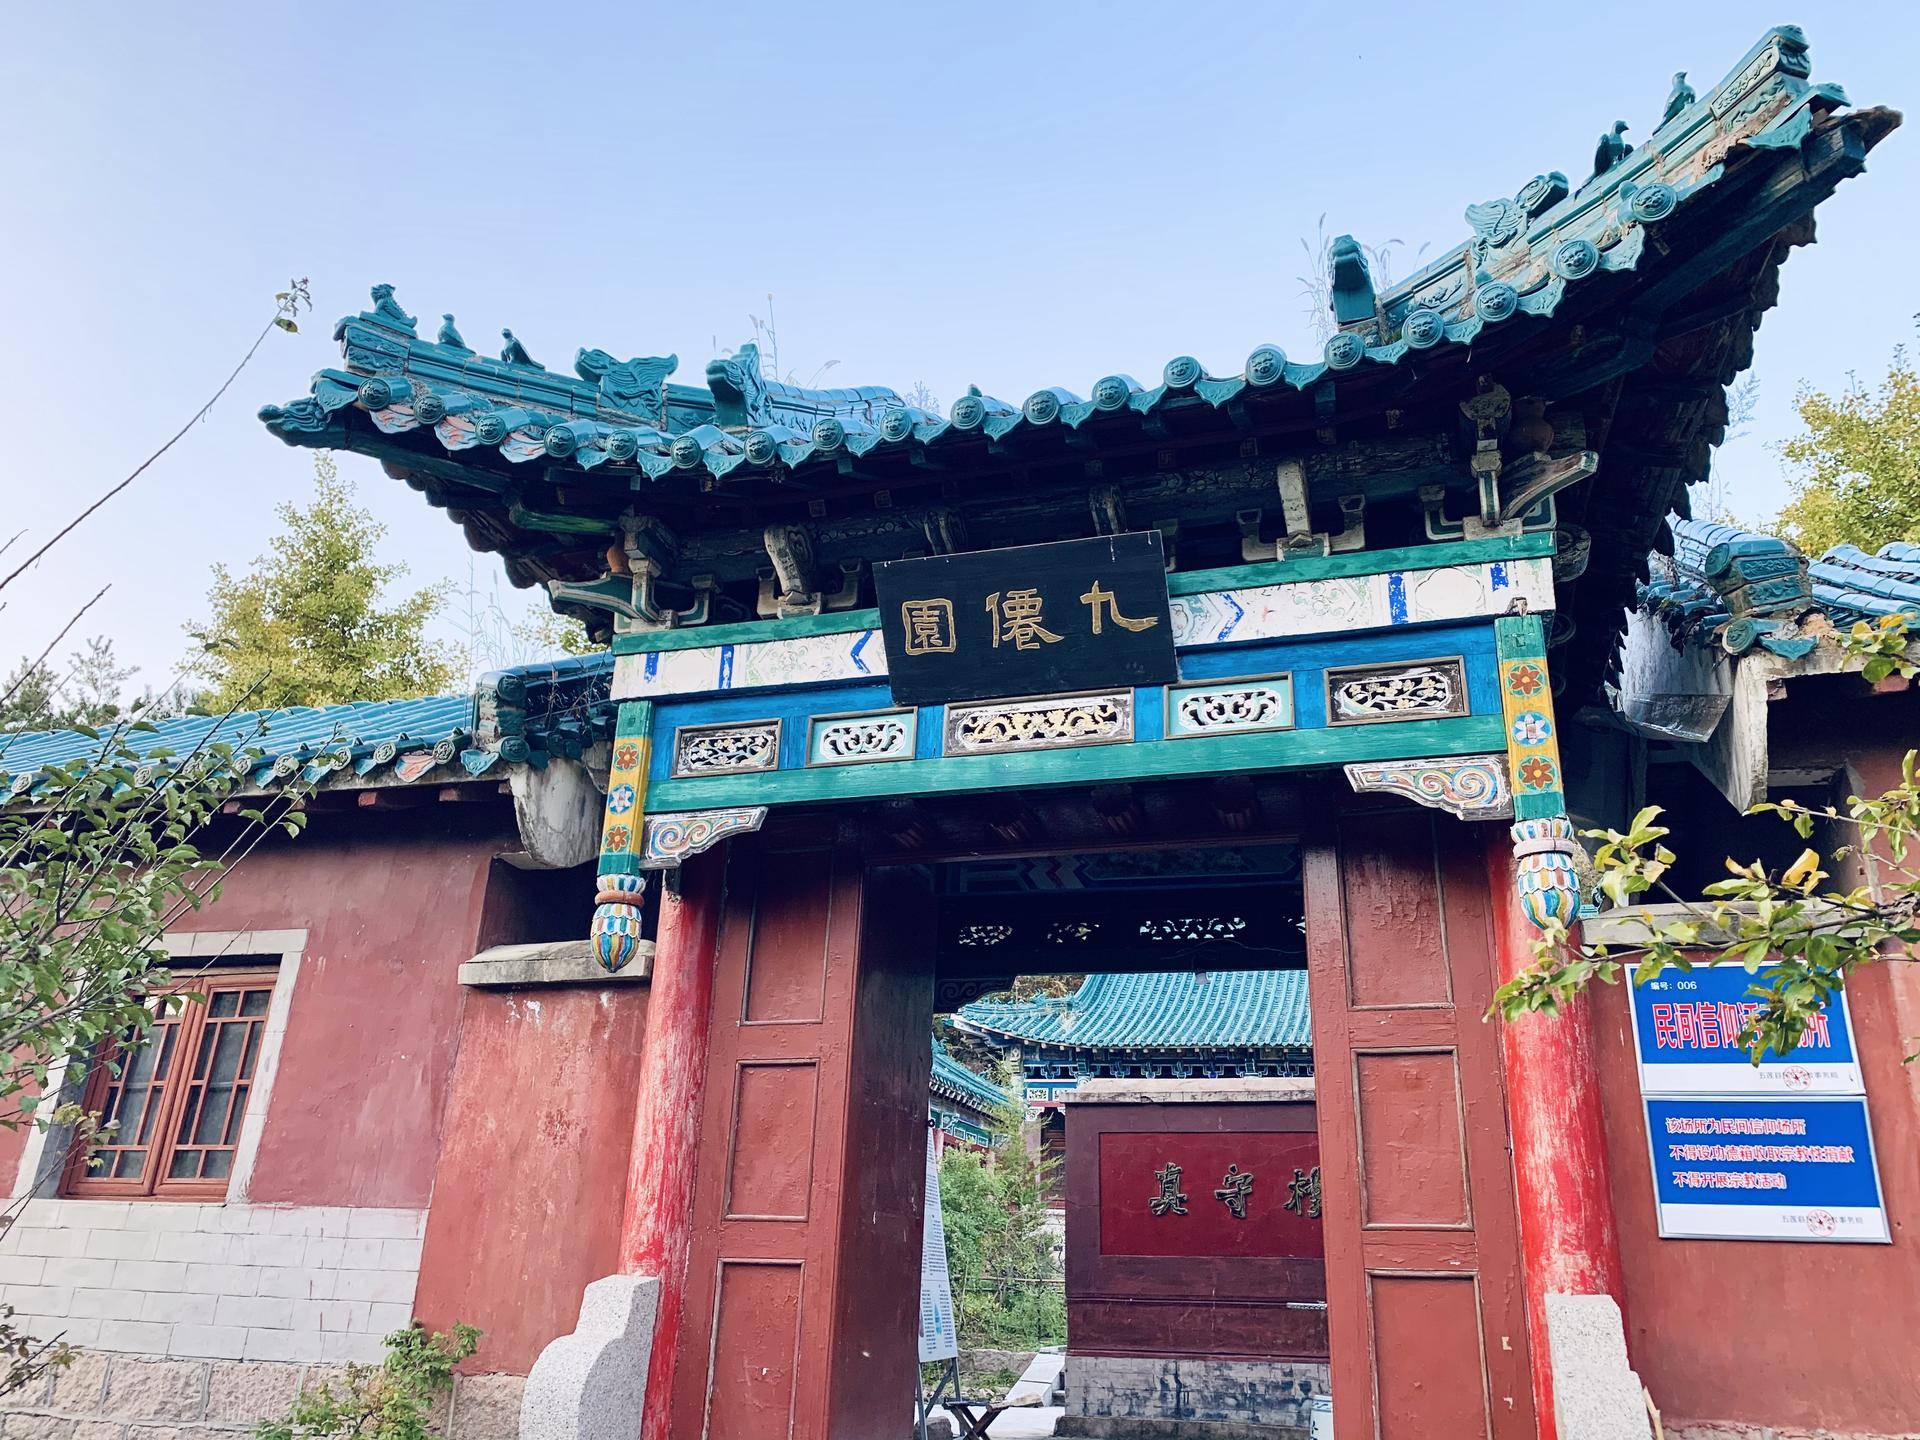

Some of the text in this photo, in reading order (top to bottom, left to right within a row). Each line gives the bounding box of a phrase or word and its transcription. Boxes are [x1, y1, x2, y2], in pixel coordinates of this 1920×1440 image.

[1653, 1001, 1831, 1049] 民间信仰活所
[1666, 1118, 1806, 1135] 该场所为民间信仰场所
[1669, 1145, 1855, 1162] 不得设功德箱收取宗教性捐献
[1673, 1172, 1787, 1189] 不得开展宗教活动
